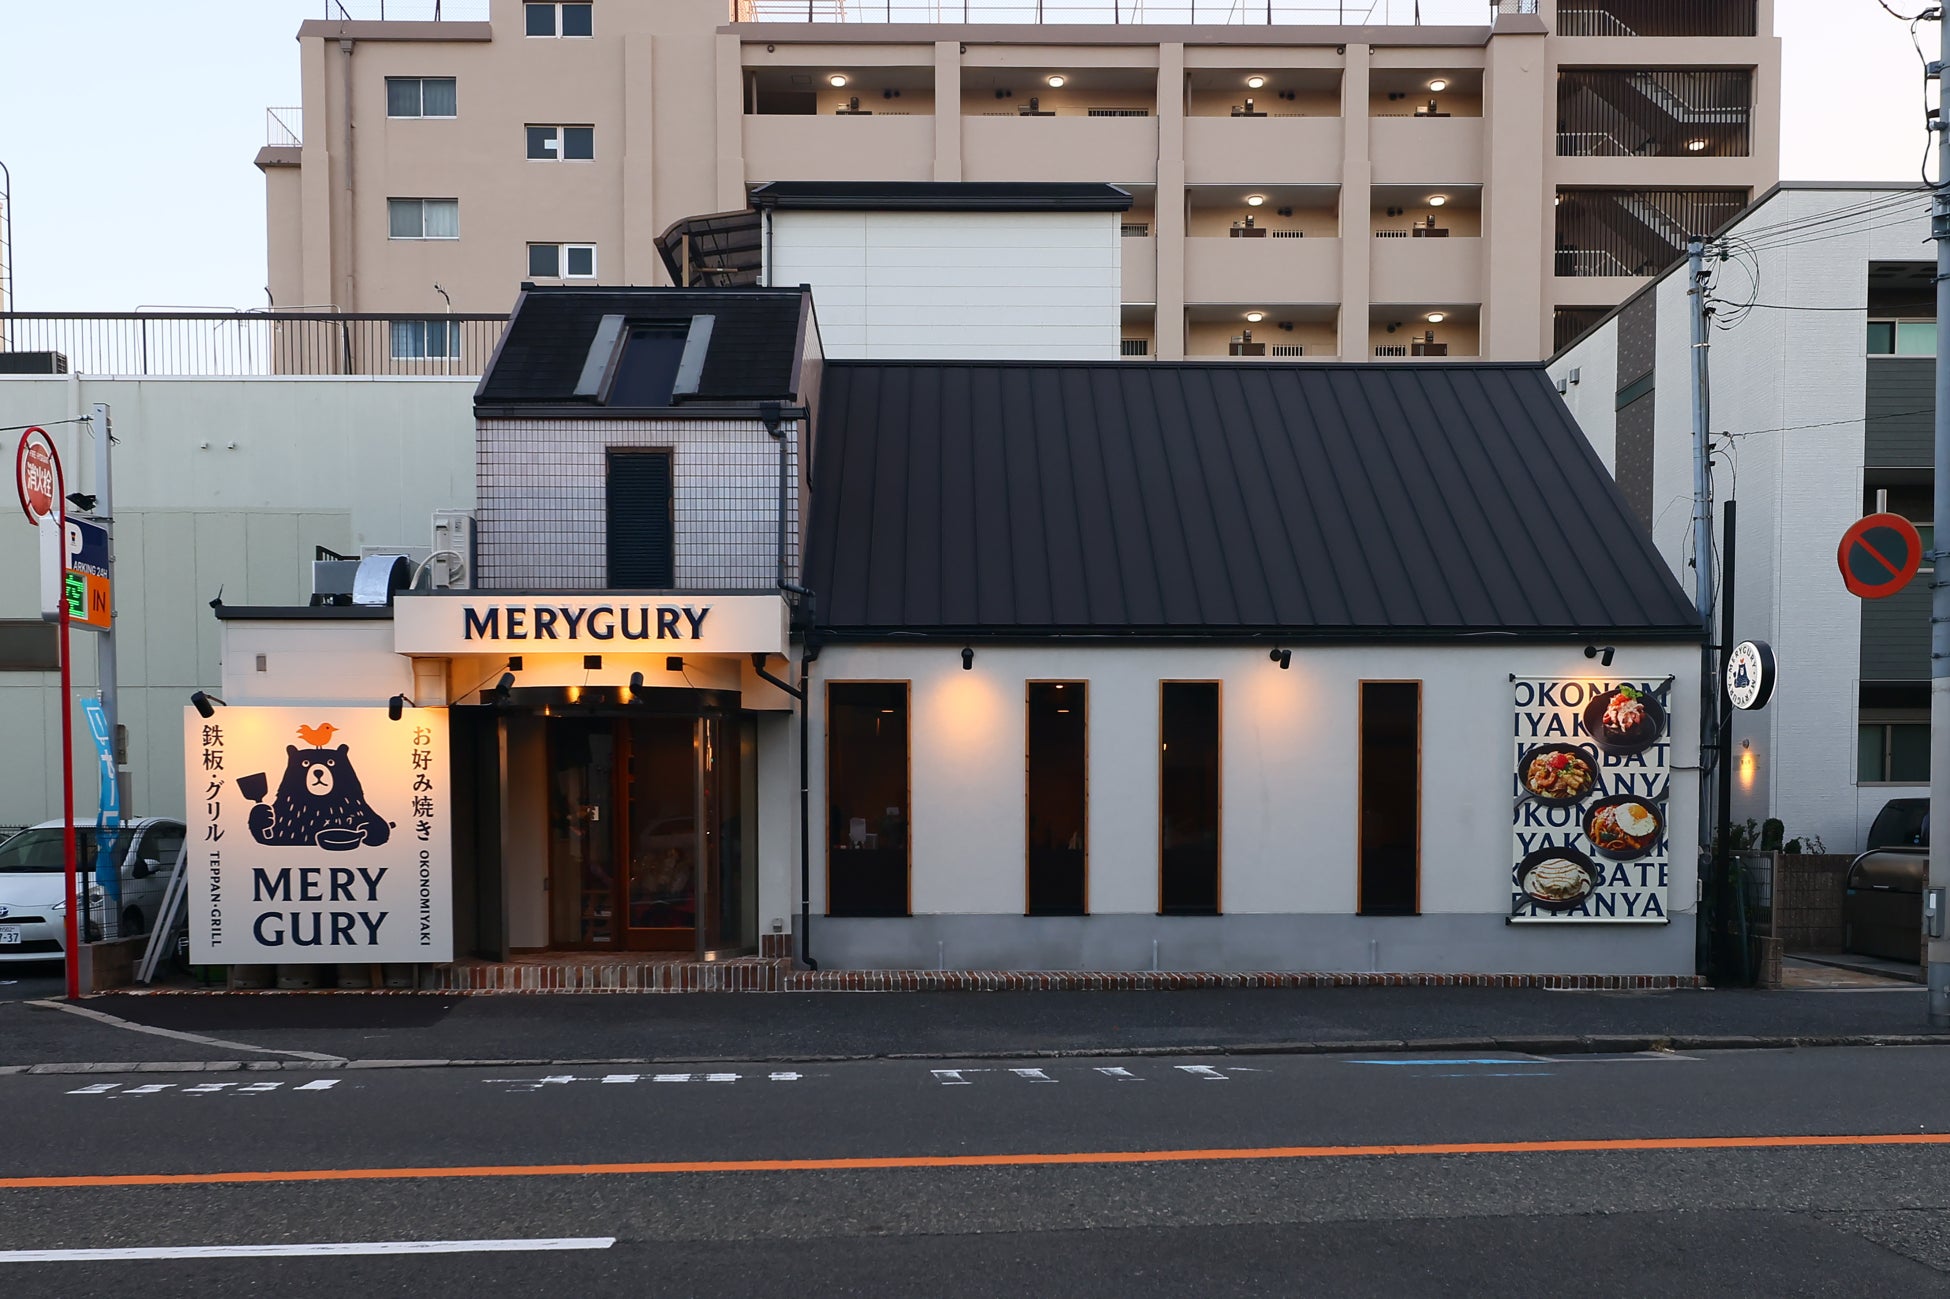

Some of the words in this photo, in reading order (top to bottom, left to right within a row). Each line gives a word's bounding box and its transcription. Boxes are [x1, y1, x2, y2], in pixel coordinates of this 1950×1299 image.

[27, 461, 51, 497] 消火栓
[93, 588, 106, 613] IN
[462, 606, 711, 640] MERYGURY
[411, 725, 434, 842] お好み焼き
[251, 867, 389, 902] MERY
[419, 849, 431, 946] OKONOMIYAKI
[253, 911, 390, 947] GURY
